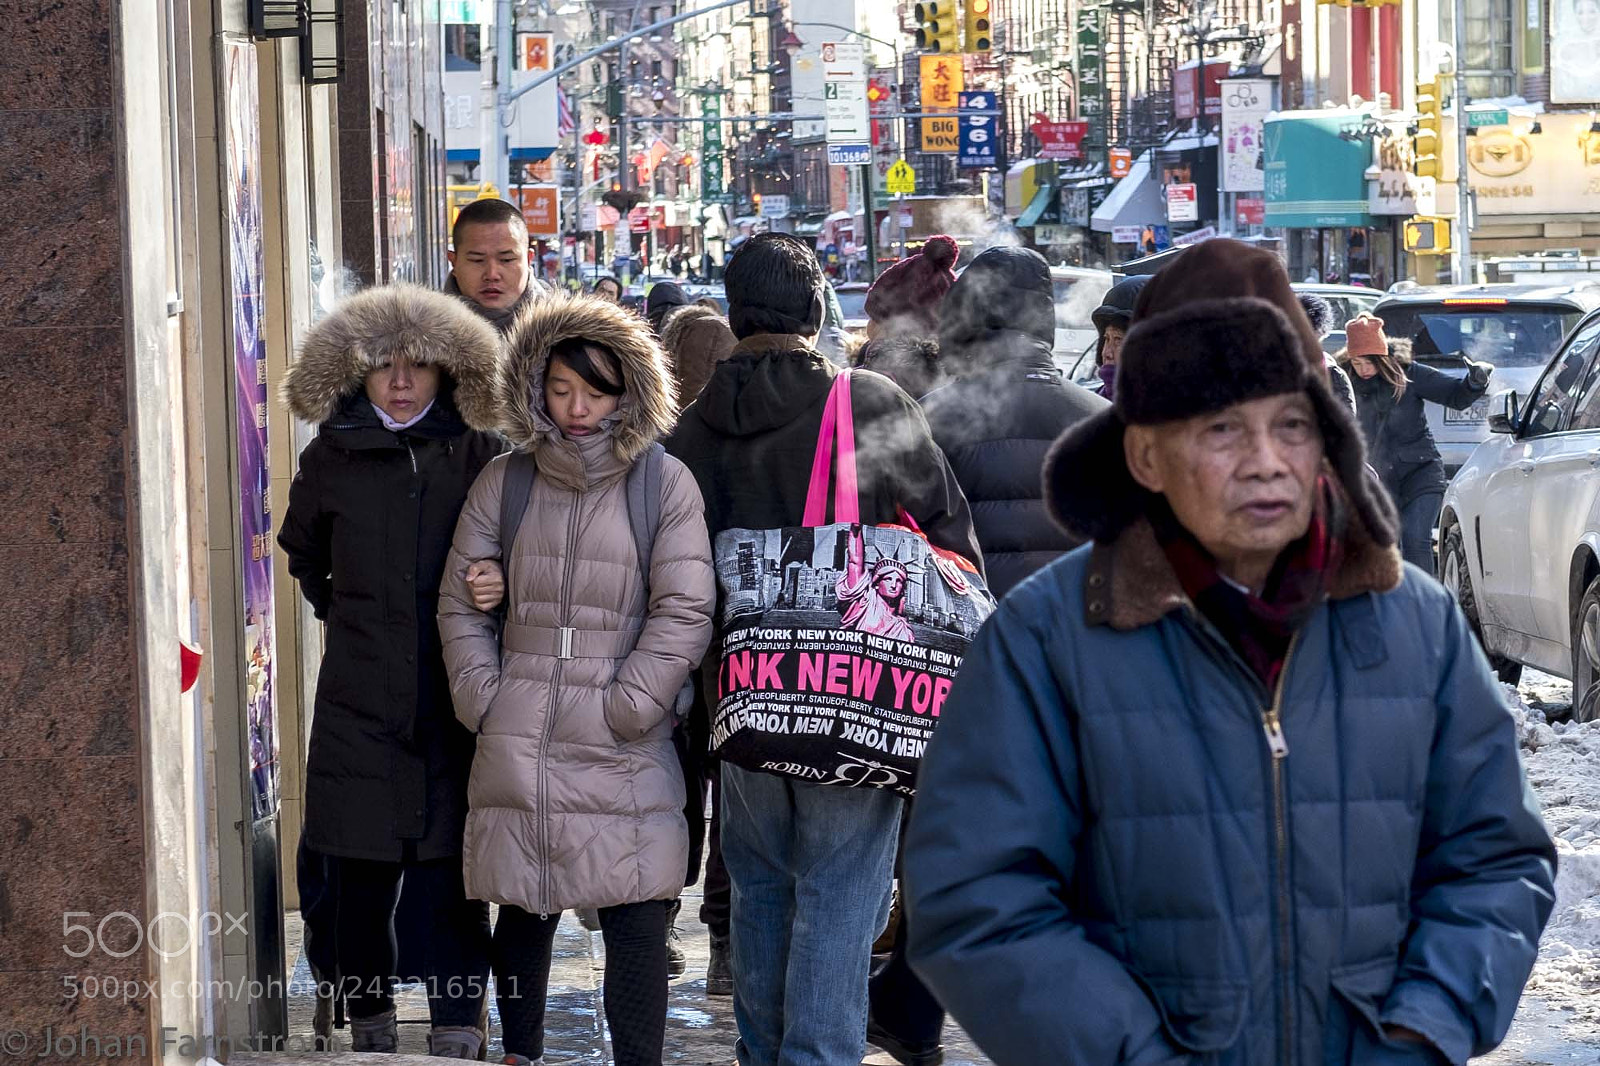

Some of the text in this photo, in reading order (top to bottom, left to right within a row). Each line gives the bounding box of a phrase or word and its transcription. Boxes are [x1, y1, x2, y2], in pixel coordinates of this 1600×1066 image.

[828, 84, 835, 99] 2
[934, 61, 951, 102] 大旺
[932, 121, 954, 132] BIG
[727, 629, 748, 645] NEW
[758, 629, 792, 640] YORK
[797, 629, 826, 640] NEW
[829, 629, 863, 643] YORK
[867, 634, 894, 651] NEW
[895, 642, 928, 659] YORK
[930, 649, 955, 664] NEW
[752, 642, 791, 650] STATUEOF
[794, 642, 864, 654] STATUEOFLIBERTY
[865, 648, 927, 670] STATUEOFLIBERTY
[798, 652, 883, 702] NEW
[891, 666, 954, 718] YOR
[749, 692, 807, 702] TUEOFLIBERTY
[809, 694, 873, 713] STATUEOFLIBERTY
[874, 707, 933, 728] STATUEOFLIBERTY
[767, 703, 790, 713] YORK
[793, 705, 814, 714] NEW
[814, 707, 837, 717] YORK
[839, 709, 860, 721] NEW
[860, 714, 882, 728] YORK
[883, 721, 904, 733] NEW
[903, 726, 921, 738] YORK
[793, 717, 834, 735] NEW
[839, 721, 889, 752] YORK
[891, 736, 928, 758] NEW
[761, 761, 828, 780] ROBIN
